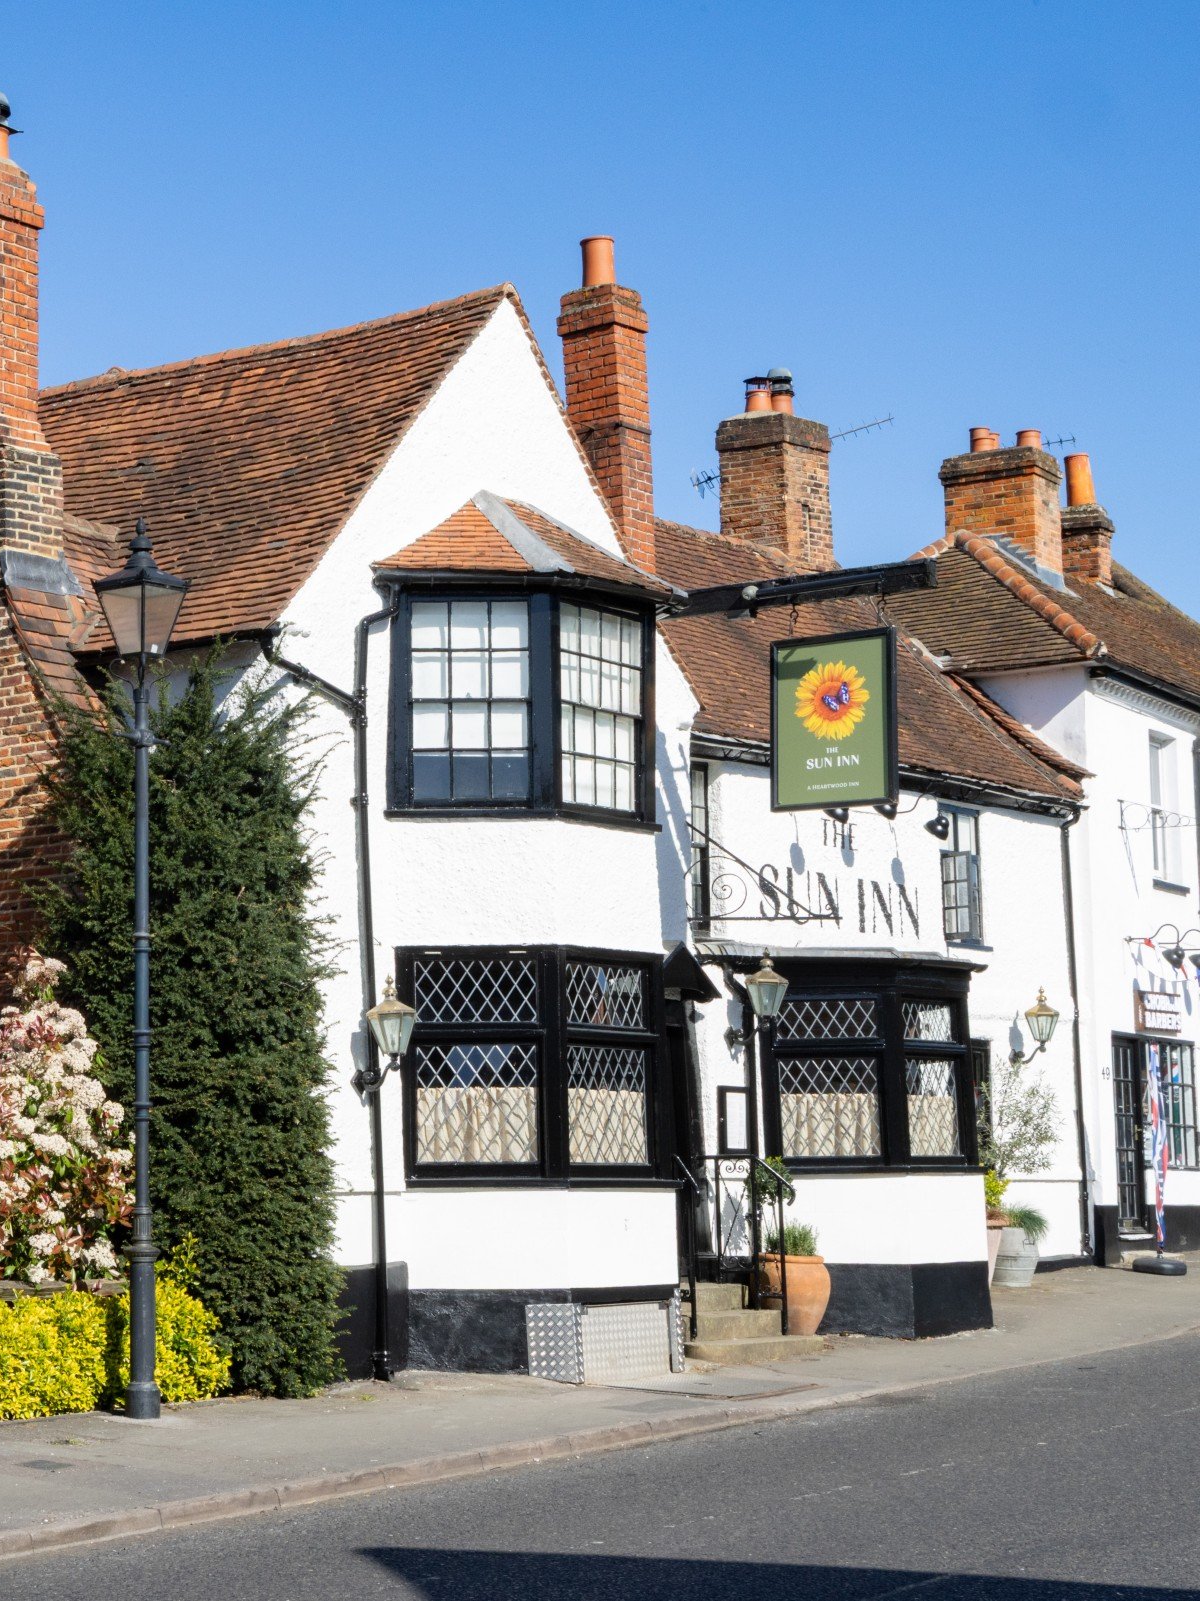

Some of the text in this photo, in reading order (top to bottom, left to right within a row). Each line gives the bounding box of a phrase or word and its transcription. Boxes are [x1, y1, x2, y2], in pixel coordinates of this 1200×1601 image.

[826, 746, 839, 754] THE
[806, 754, 860, 770] SUN INN
[812, 782, 848, 790] HEARTWOOD
[820, 817, 858, 851] THE
[759, 863, 920, 940] SUN INN
[1101, 1066, 1111, 1081] 49
